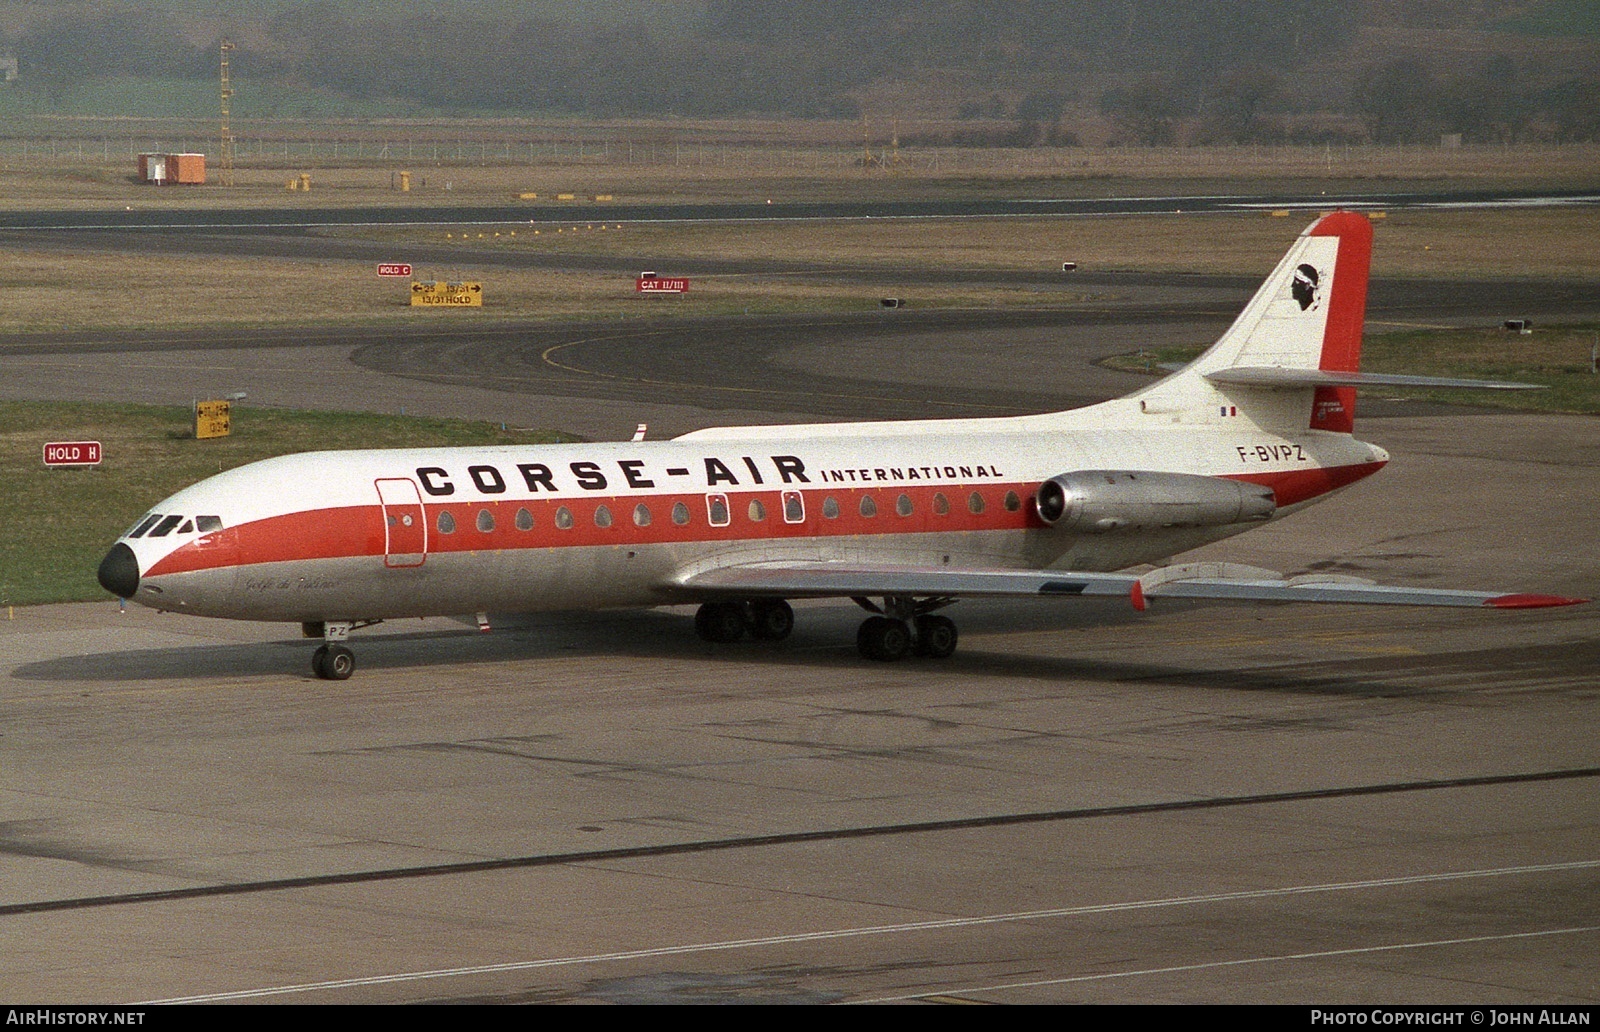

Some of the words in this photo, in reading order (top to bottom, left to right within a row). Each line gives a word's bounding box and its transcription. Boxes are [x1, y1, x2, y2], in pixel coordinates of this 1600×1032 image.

[641, 280, 658, 289] CAT
[662, 280, 684, 289] II/III
[422, 296, 444, 305] 13/31
[445, 296, 471, 304] HOLD
[48, 447, 80, 460] HOLD
[88, 446, 96, 460] H
[1236, 444, 1306, 462] F-BVPZ
[416, 455, 811, 496] CORSE-AIR
[821, 465, 1003, 483] INTERNATIONAL
[329, 626, 346, 637] PZ
